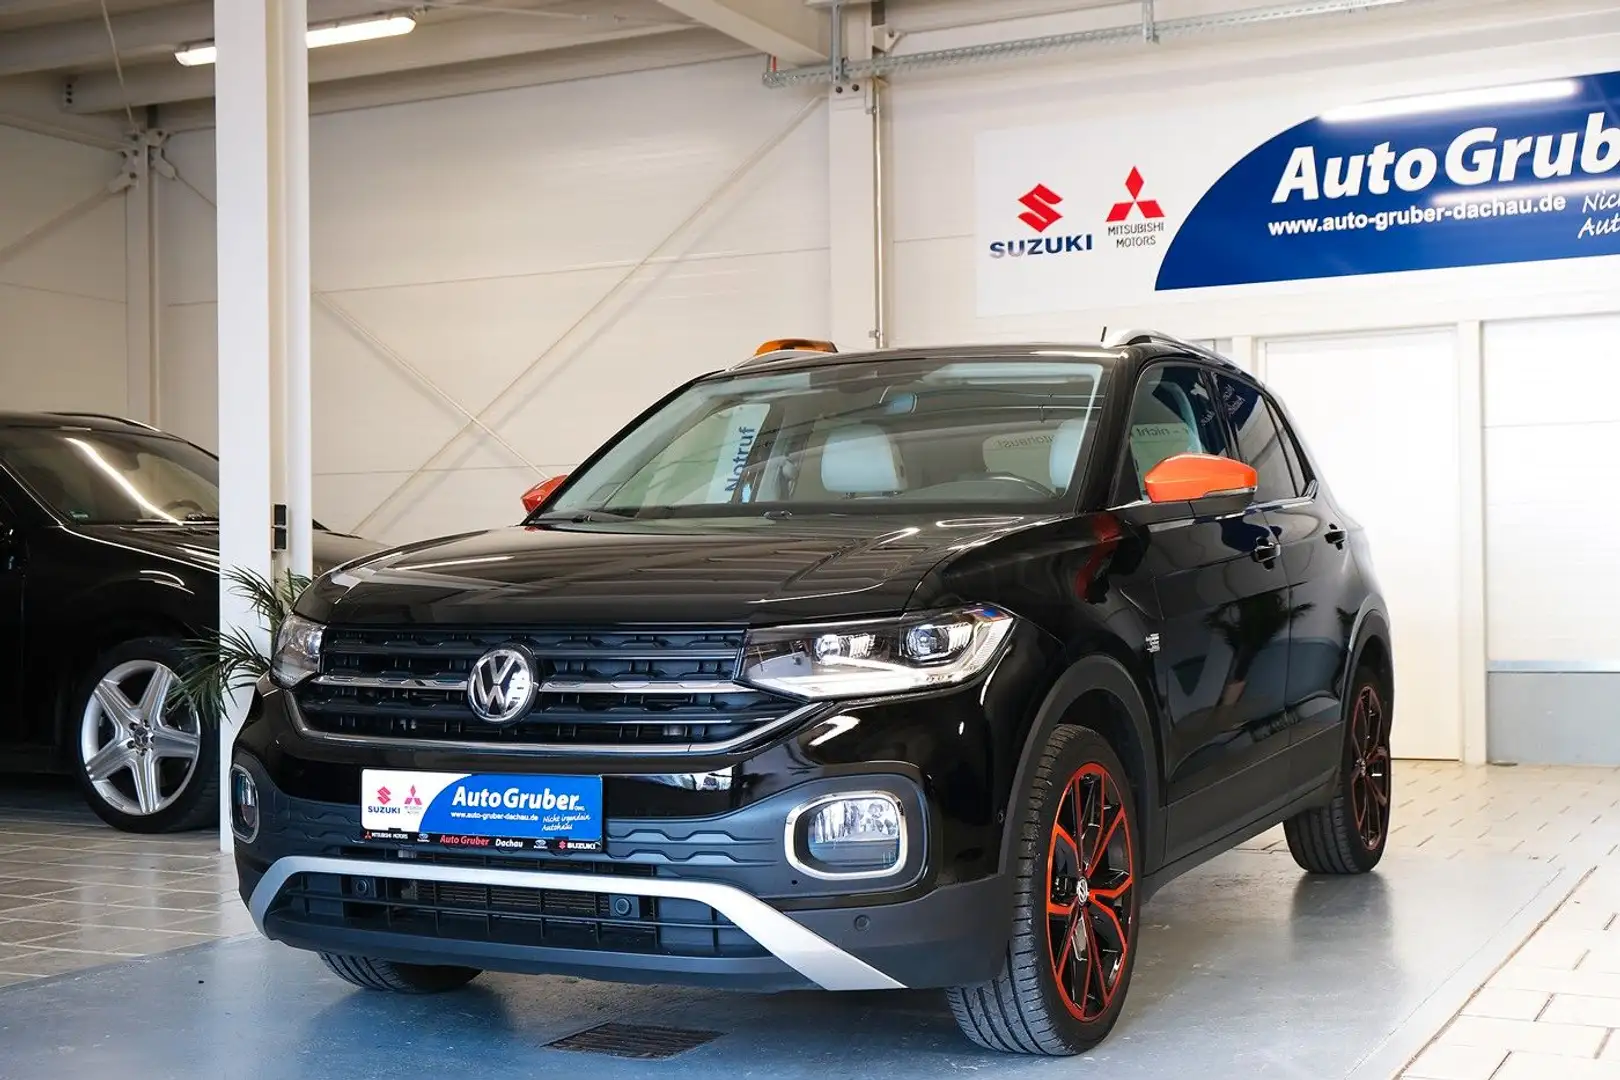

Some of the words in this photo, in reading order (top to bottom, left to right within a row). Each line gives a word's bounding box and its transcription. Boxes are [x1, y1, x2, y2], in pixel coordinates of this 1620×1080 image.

[1271, 141, 1437, 204] Auto
[1582, 189, 1620, 213] Nic
[1268, 193, 1566, 236] www.auto-gruber-dachau.de
[1108, 221, 1164, 237] MITSUBISHI
[989, 233, 1093, 259] SUZUKI
[1116, 235, 1156, 248] MOTORS
[367, 805, 401, 814] SUZUKI
[450, 811, 539, 822] www.auto-gruber-dachau.de
[440, 834, 460, 844] Auto
[460, 835, 491, 846] Gruber
[495, 838, 524, 848] Dachau
